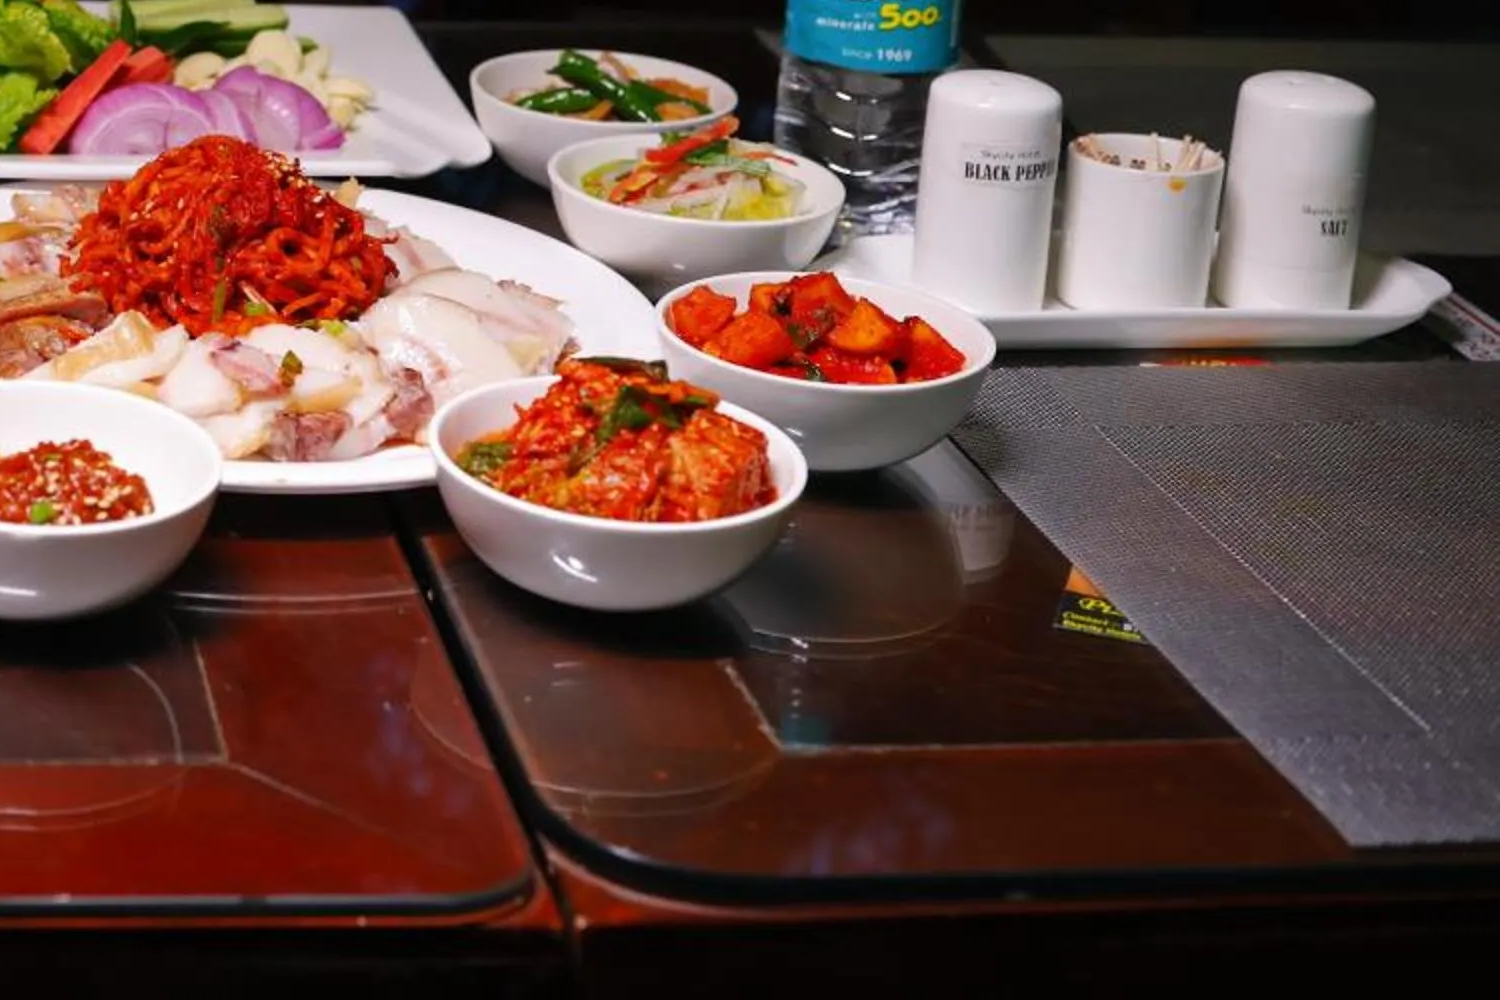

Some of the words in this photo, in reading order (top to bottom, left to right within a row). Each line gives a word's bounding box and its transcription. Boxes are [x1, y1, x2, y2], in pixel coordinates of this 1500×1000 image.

[879, 3, 941, 31] 500
[877, 48, 913, 62] 1969
[964, 161, 1010, 181] BLACK
[1015, 159, 1056, 181] PEPP
